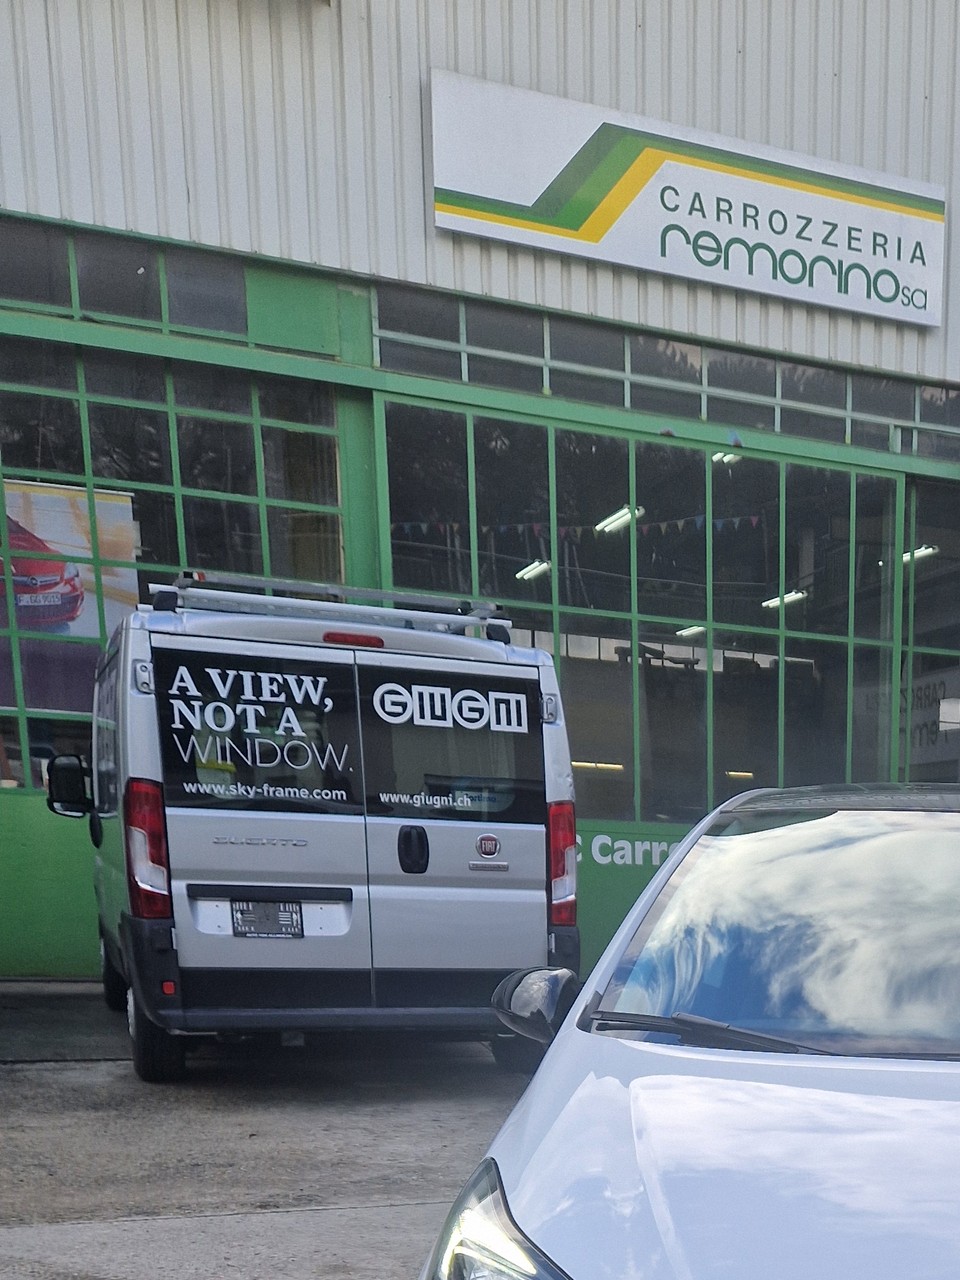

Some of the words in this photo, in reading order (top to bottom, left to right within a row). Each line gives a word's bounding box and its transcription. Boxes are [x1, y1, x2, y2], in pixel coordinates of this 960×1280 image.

[659, 185, 927, 267] CARROZZERIA
[660, 223, 901, 303] remorino
[168, 665, 202, 697] A
[204, 667, 334, 712] VIEW,
[372, 682, 529, 734] GIUGNI
[168, 698, 266, 735] NOT
[274, 706, 307, 737] A
[172, 732, 354, 773] WINDOW.
[182, 781, 347, 801] www.sky-frame.com
[379, 790, 472, 808] www.giugni.ch
[481, 840, 496, 852] FIAT
